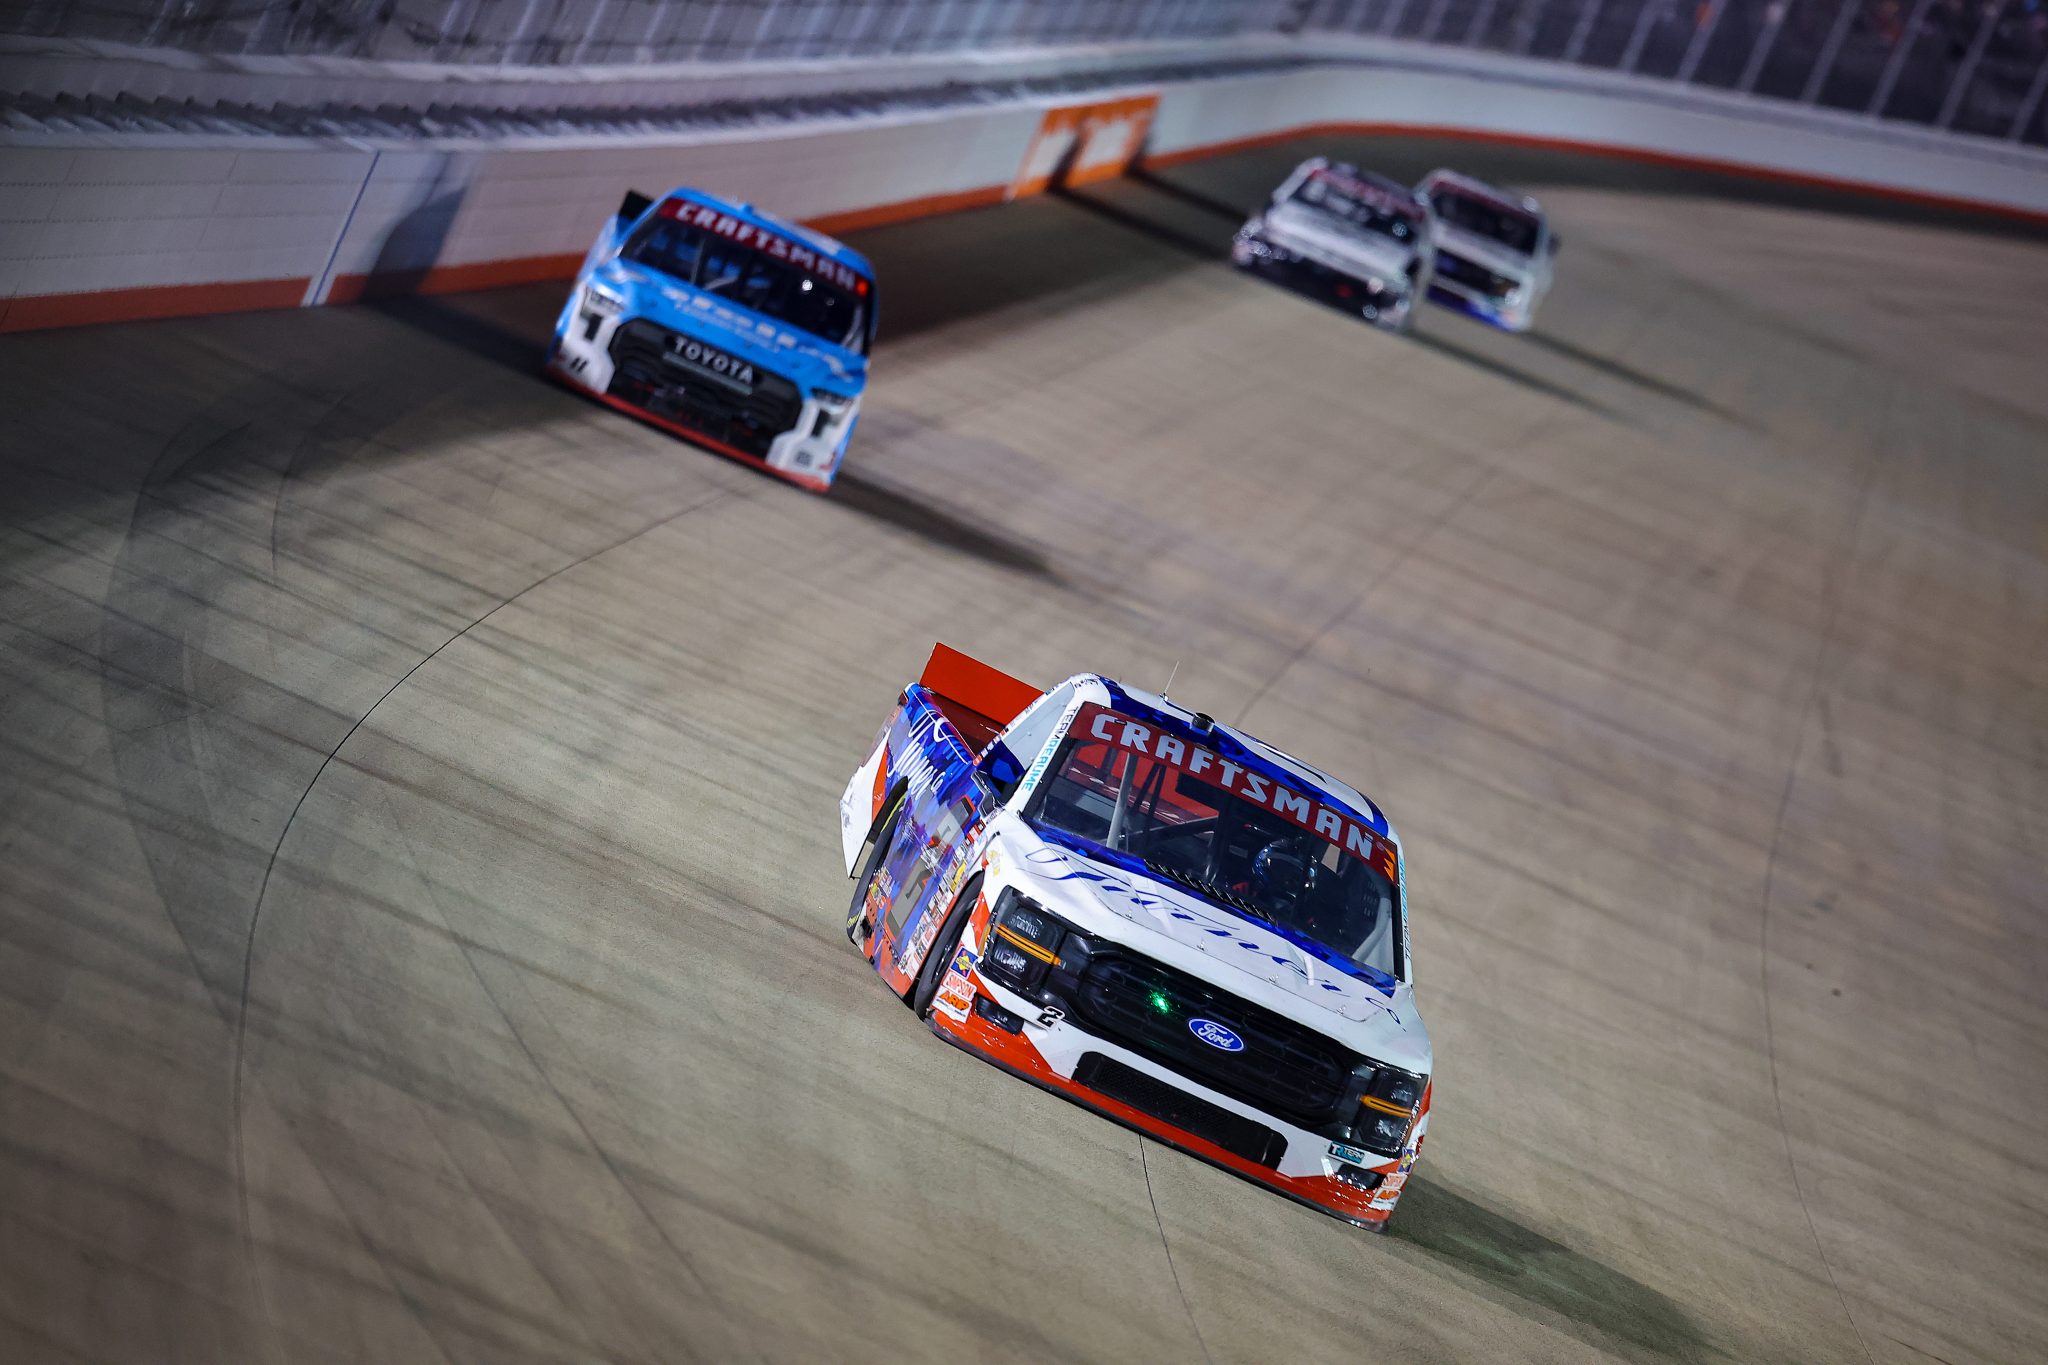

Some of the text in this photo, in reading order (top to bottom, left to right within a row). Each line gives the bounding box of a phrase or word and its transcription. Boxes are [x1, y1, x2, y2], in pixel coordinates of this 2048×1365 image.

[676, 202, 855, 291] CRAFTSMAN
[674, 336, 753, 383] TOYOTA
[1091, 713, 1374, 861] CRAFTSMAN
[939, 990, 970, 1011] ARP
[1037, 1006, 1065, 1031] 2
[1197, 1022, 1235, 1048] Ford
